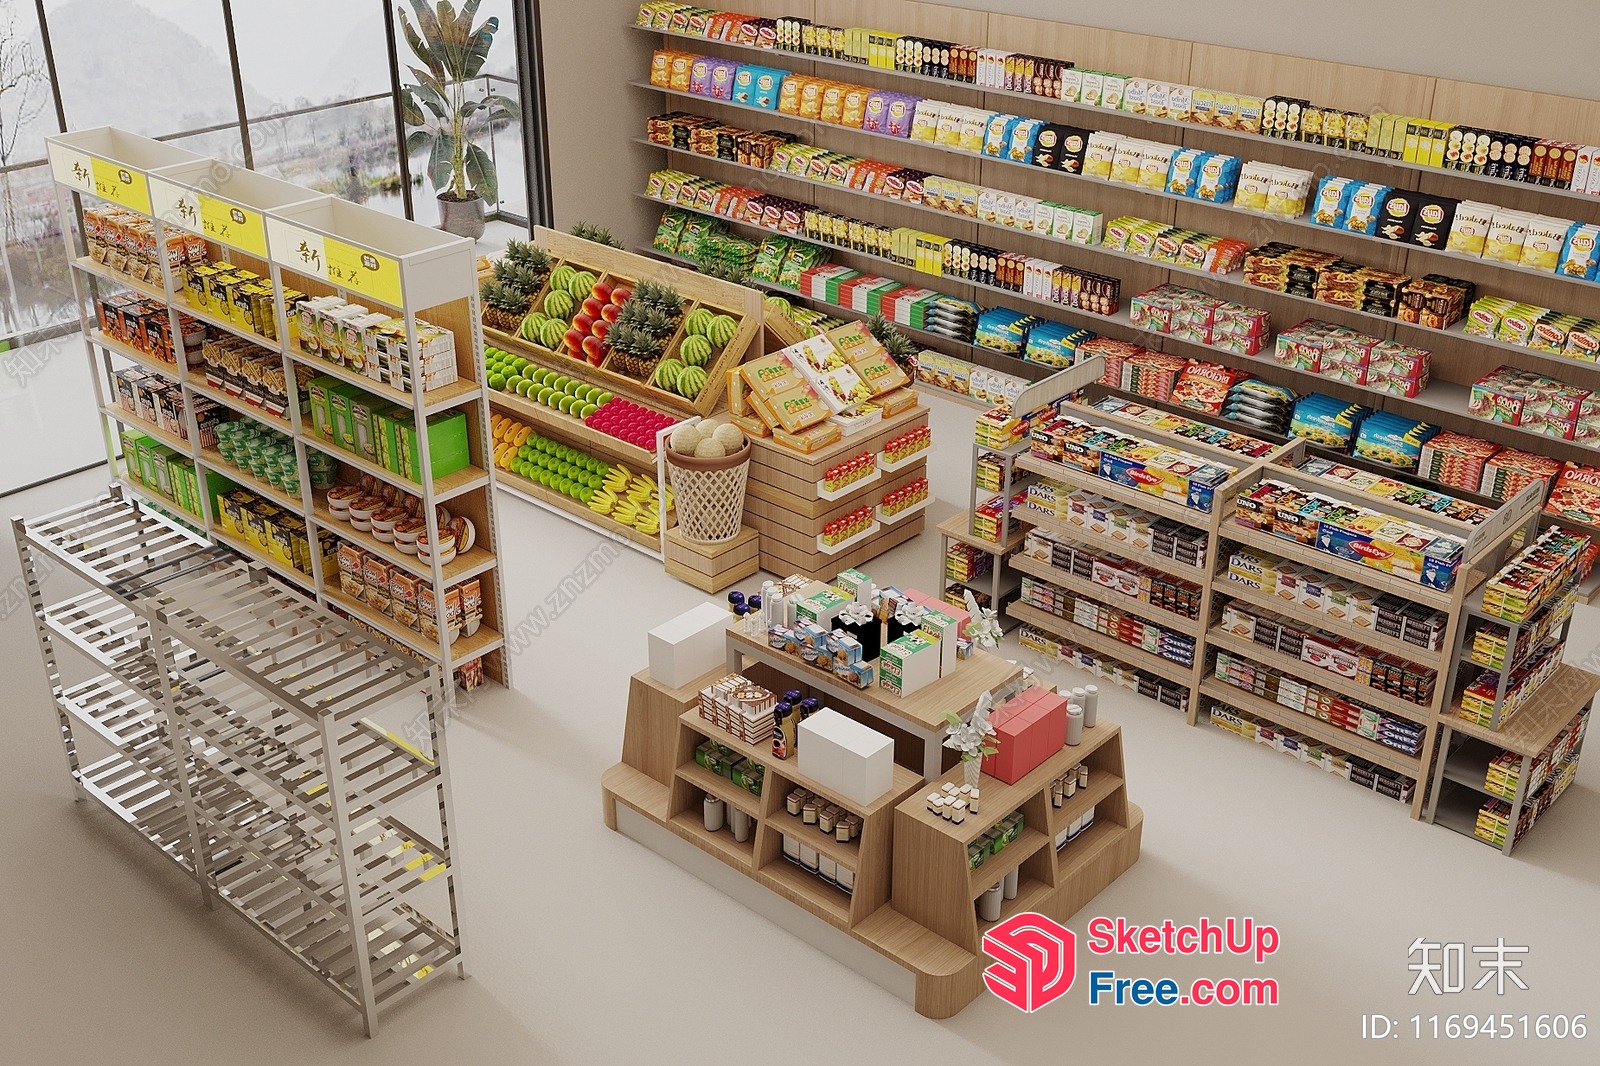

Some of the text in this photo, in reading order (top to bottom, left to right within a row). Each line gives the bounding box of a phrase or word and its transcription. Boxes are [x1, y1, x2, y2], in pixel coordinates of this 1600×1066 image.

[1031, 432, 1049, 443] UNO
[1065, 442, 1084, 453] UNO
[1029, 487, 1056, 502] DARS
[1028, 501, 1056, 516] DARS
[1236, 498, 1257, 510] UNO
[1277, 510, 1299, 523] UNO
[1231, 557, 1263, 574] DARS
[1229, 573, 1261, 589] DARS
[1020, 630, 1047, 646] DARS
[1212, 708, 1243, 726] DARS
